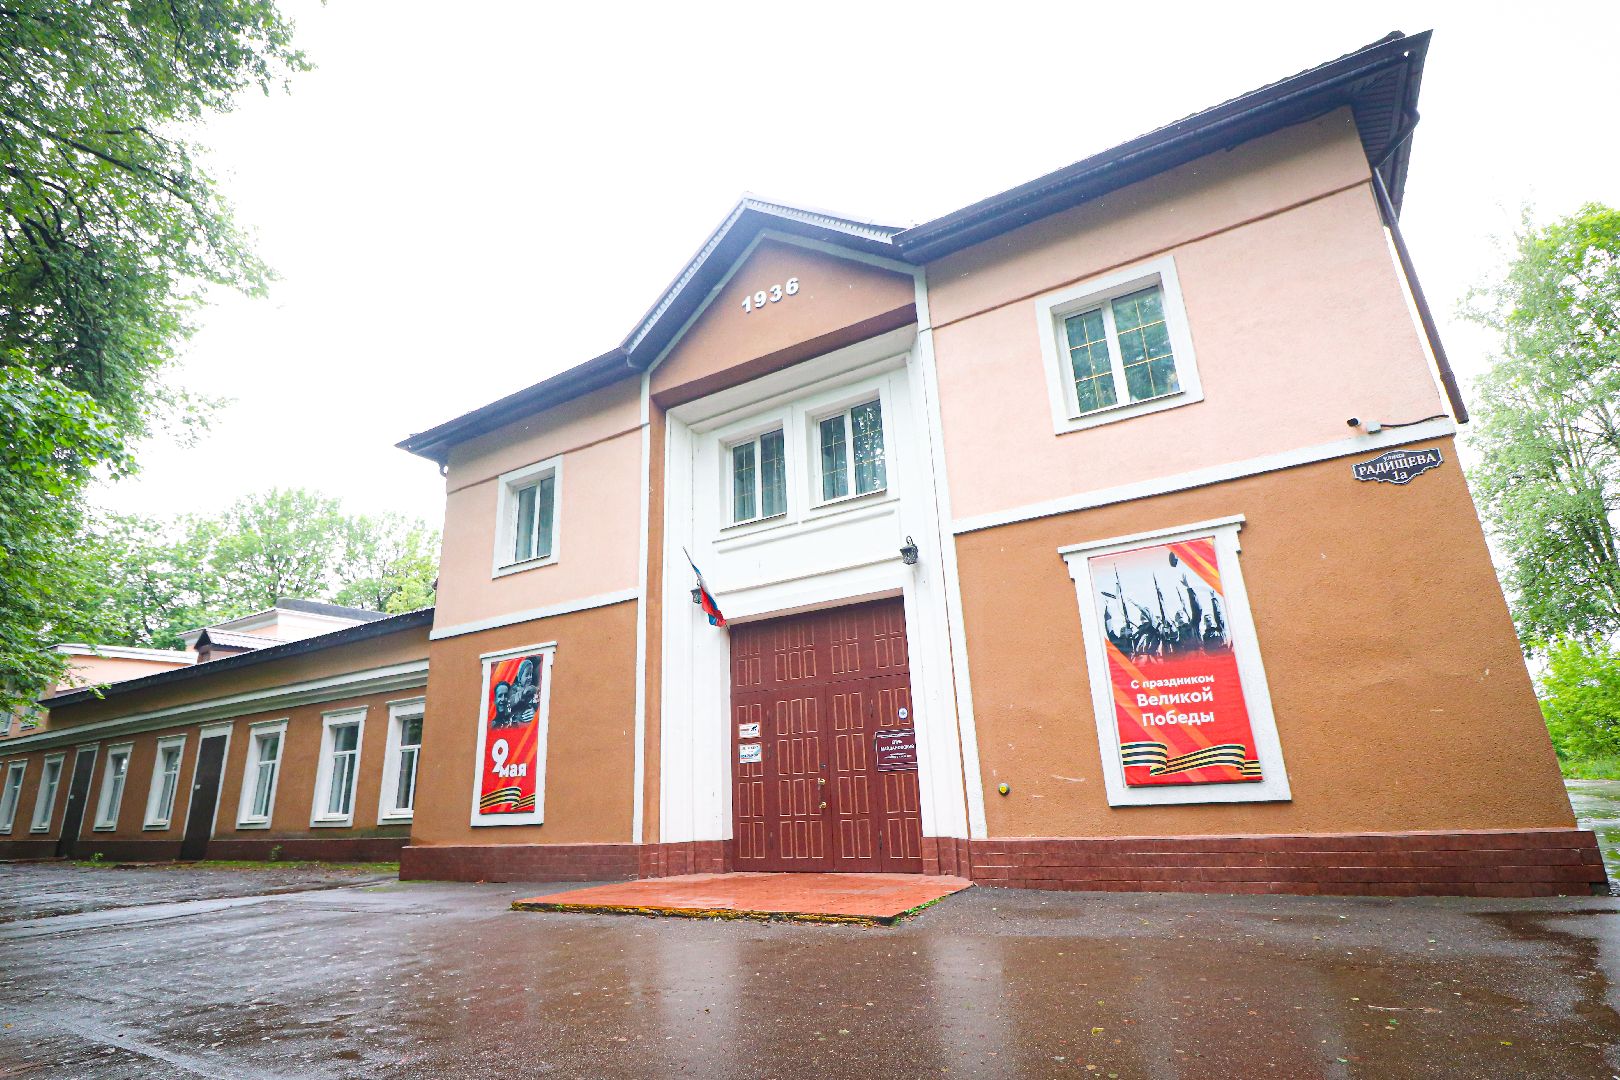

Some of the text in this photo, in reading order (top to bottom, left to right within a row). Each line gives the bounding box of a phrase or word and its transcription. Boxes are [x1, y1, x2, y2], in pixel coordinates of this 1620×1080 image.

[741, 277, 800, 313] 1936
[1358, 453, 1437, 476] РАДИЩЕВА
[1392, 470, 1408, 480] 1а
[1130, 674, 1215, 689] С праздником
[1136, 686, 1214, 707] Великой
[1141, 709, 1215, 727] Победы
[491, 738, 509, 773] 9
[498, 763, 527, 778] мая
